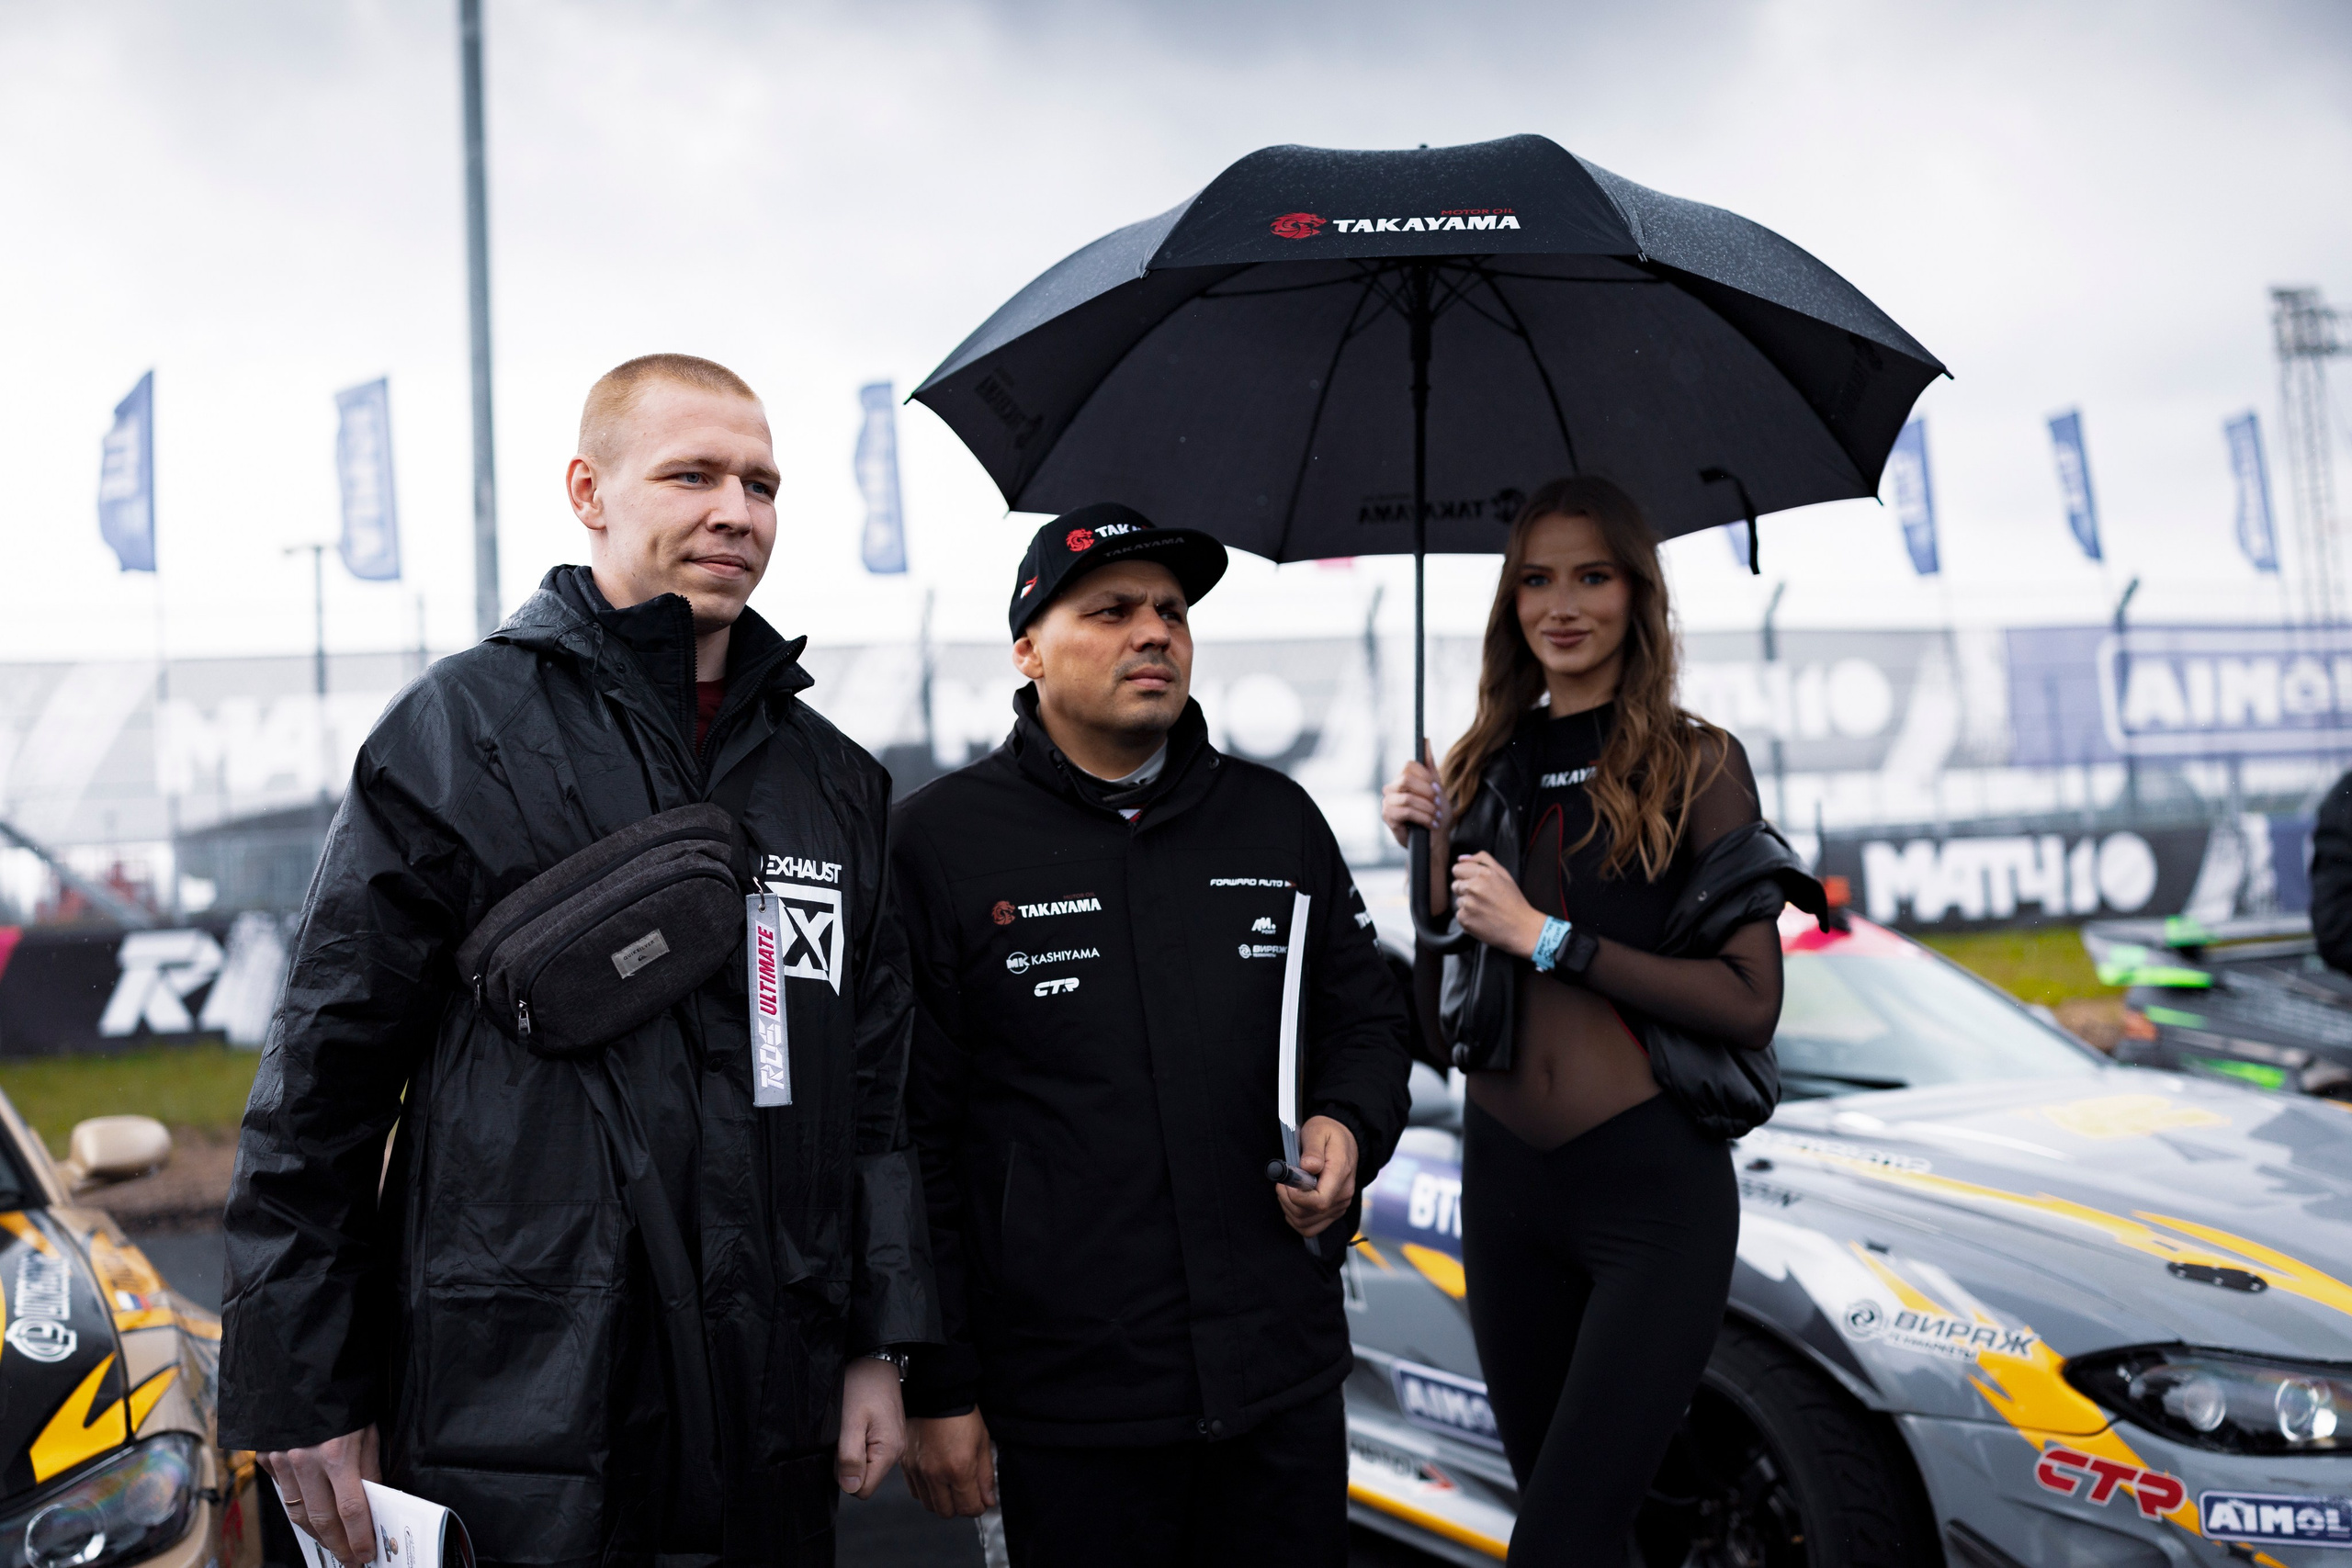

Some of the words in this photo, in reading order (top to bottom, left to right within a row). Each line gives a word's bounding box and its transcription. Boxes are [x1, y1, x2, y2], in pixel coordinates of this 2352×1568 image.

[1332, 215, 1521, 233] TAKAYAMA
[1102, 536, 1185, 558] TAKAYAMA
[766, 854, 842, 884] EXHAUST
[1210, 878, 1257, 886] FORWARD
[1258, 879, 1283, 887] AUTO
[1017, 898, 1102, 918] TAKAYAMA
[623, 940, 655, 961] QUIKSILVER
[1031, 947, 1100, 965] KASHIYAMA
[757, 924, 777, 1017] ULTIMATE
[1894, 1310, 2035, 1357] ВИРАЖ
[2034, 1446, 2188, 1522] CTR
[2207, 1499, 2352, 1536] AIMOL
